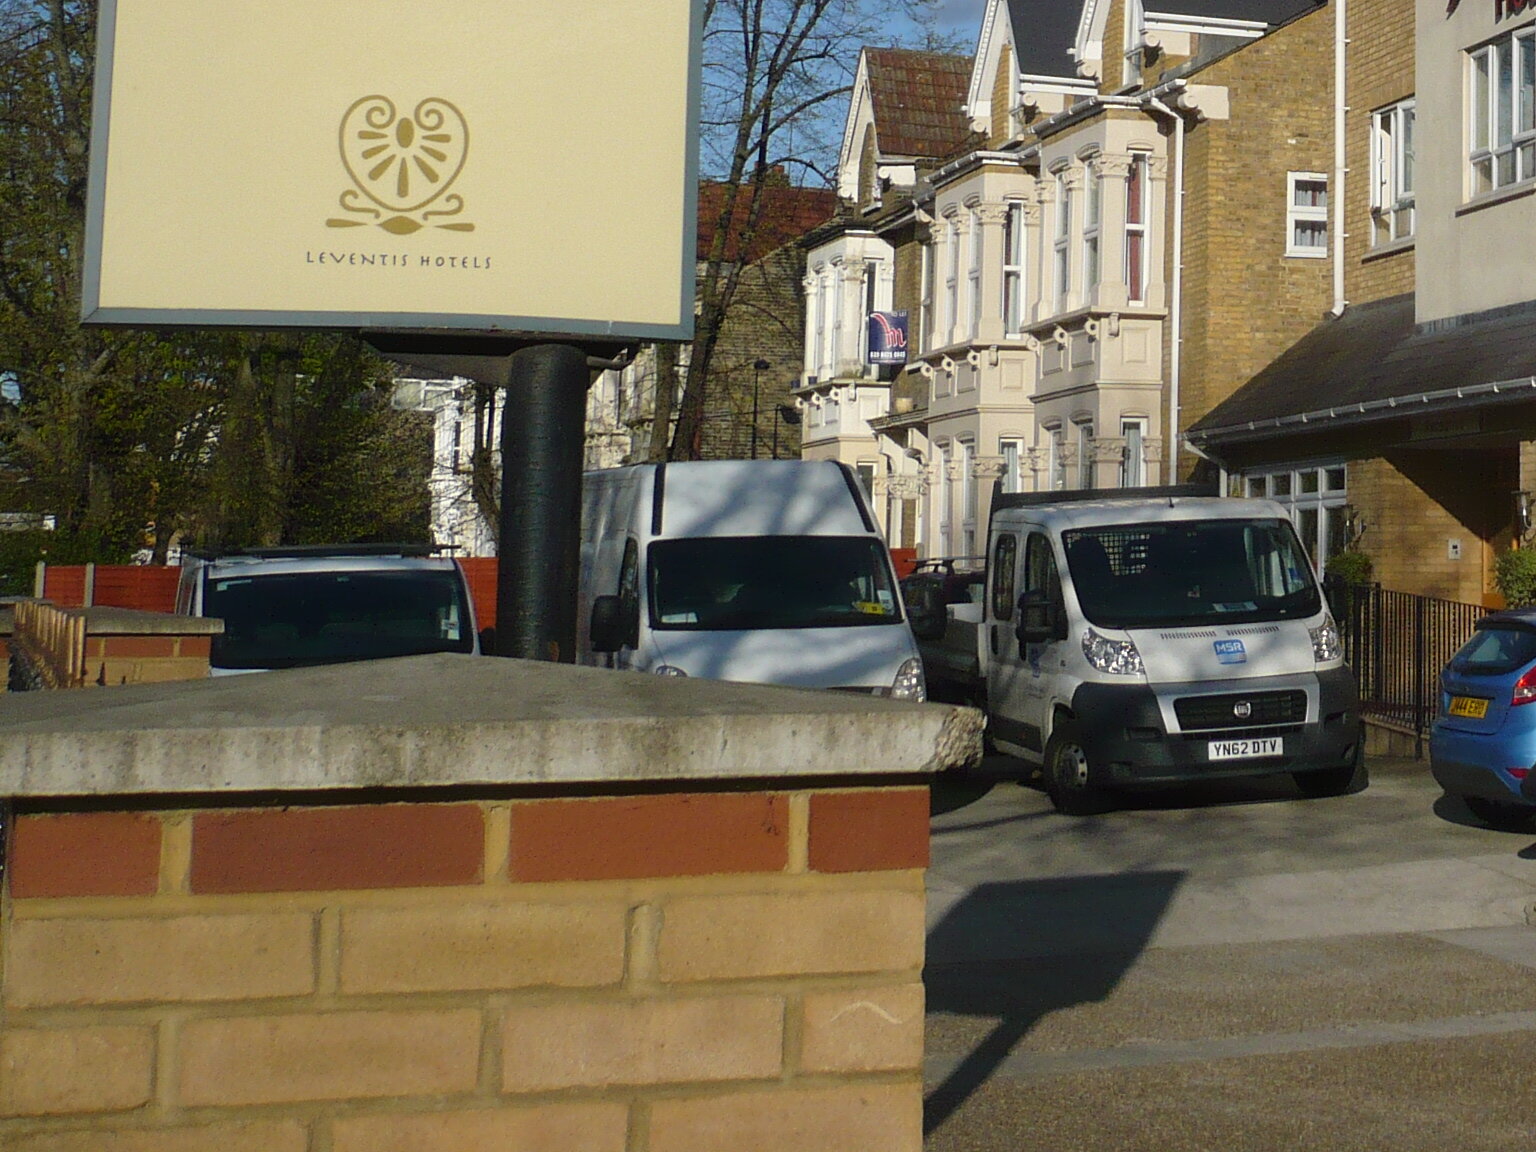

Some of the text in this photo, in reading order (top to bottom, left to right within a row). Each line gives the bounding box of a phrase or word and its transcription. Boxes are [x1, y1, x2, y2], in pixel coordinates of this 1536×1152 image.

[306, 249, 493, 270] LEVENTIS HOTELS
[1216, 642, 1243, 653] MSR
[1214, 739, 1277, 756] YN62 DTV
